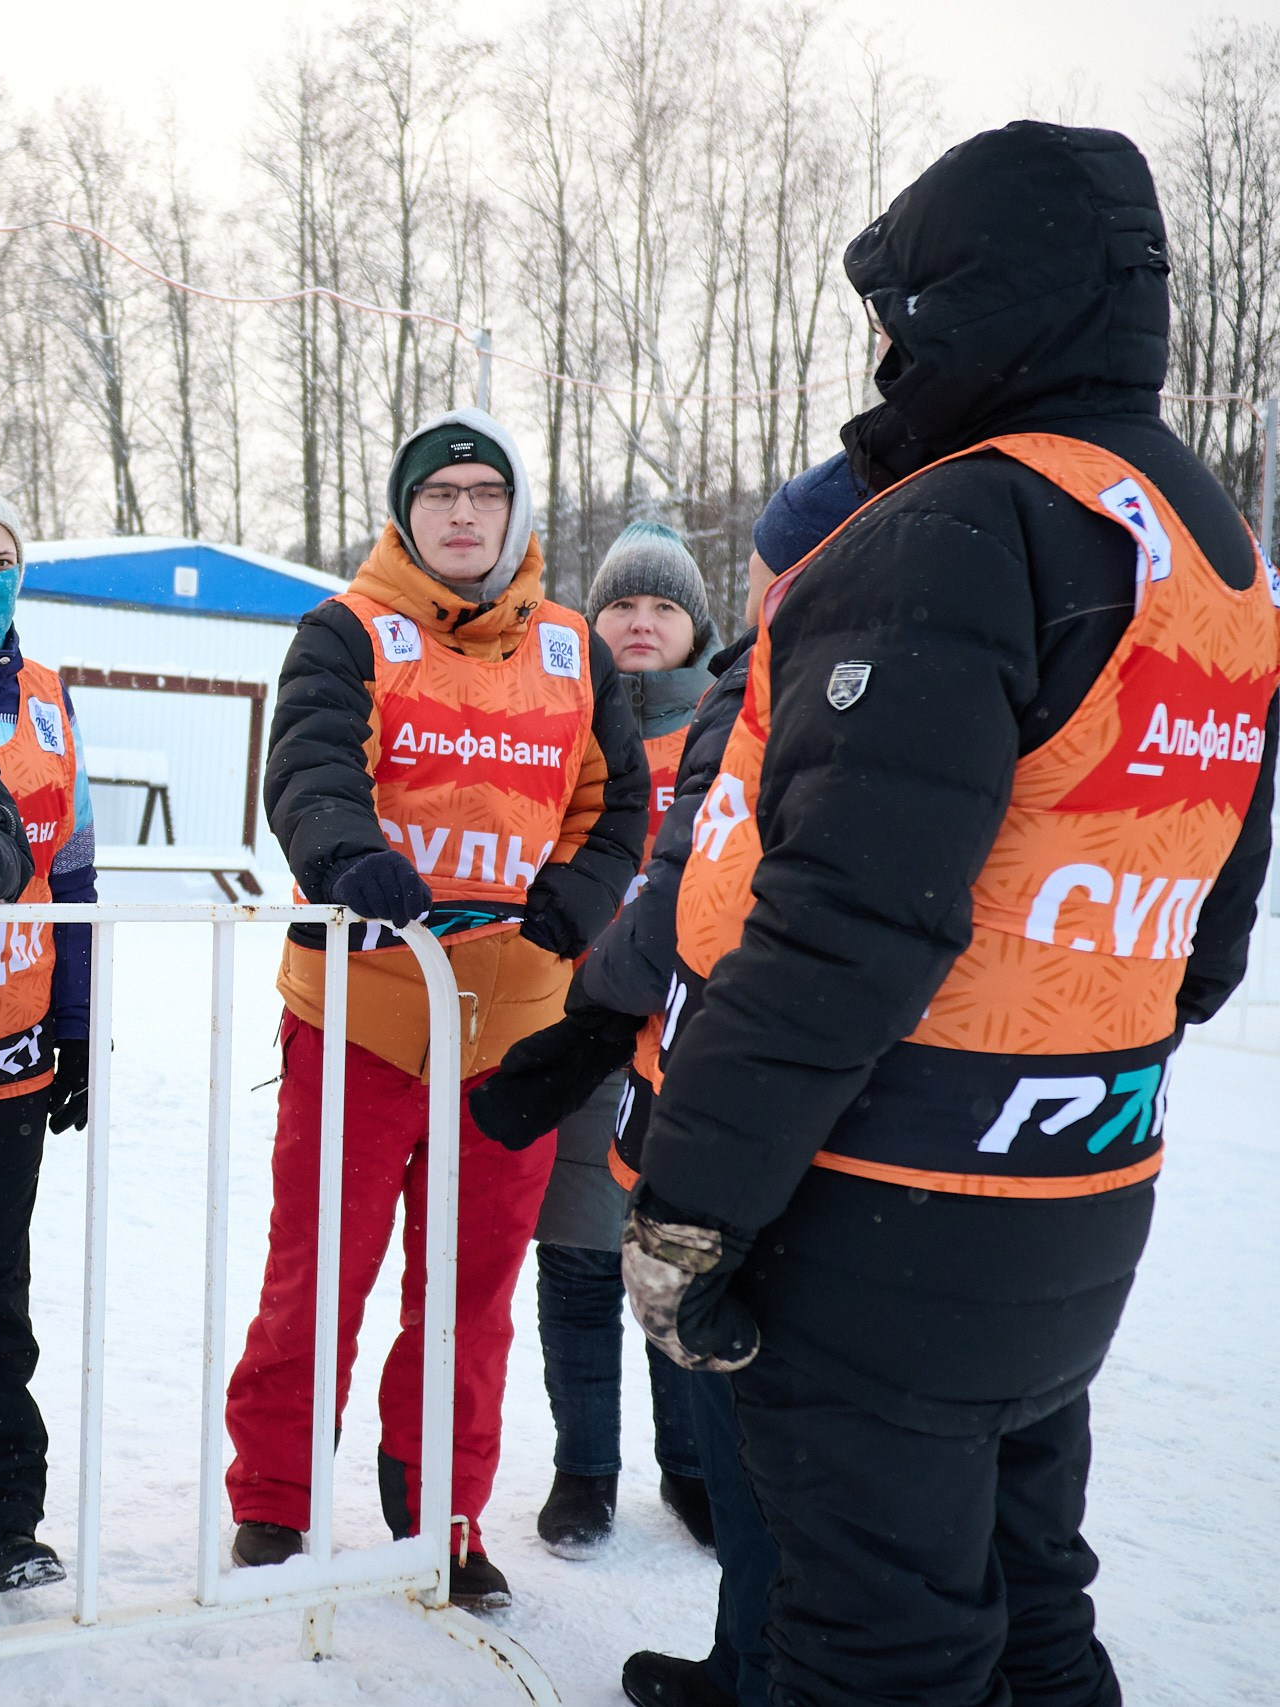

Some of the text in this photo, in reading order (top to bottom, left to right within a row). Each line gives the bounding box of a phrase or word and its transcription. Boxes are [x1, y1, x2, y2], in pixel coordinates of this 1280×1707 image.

[549, 639, 573, 657] 2024
[392, 722, 563, 769] Альфа Банк
[1136, 702, 1229, 771] Альфа
[1025, 863, 1214, 960] СУД
